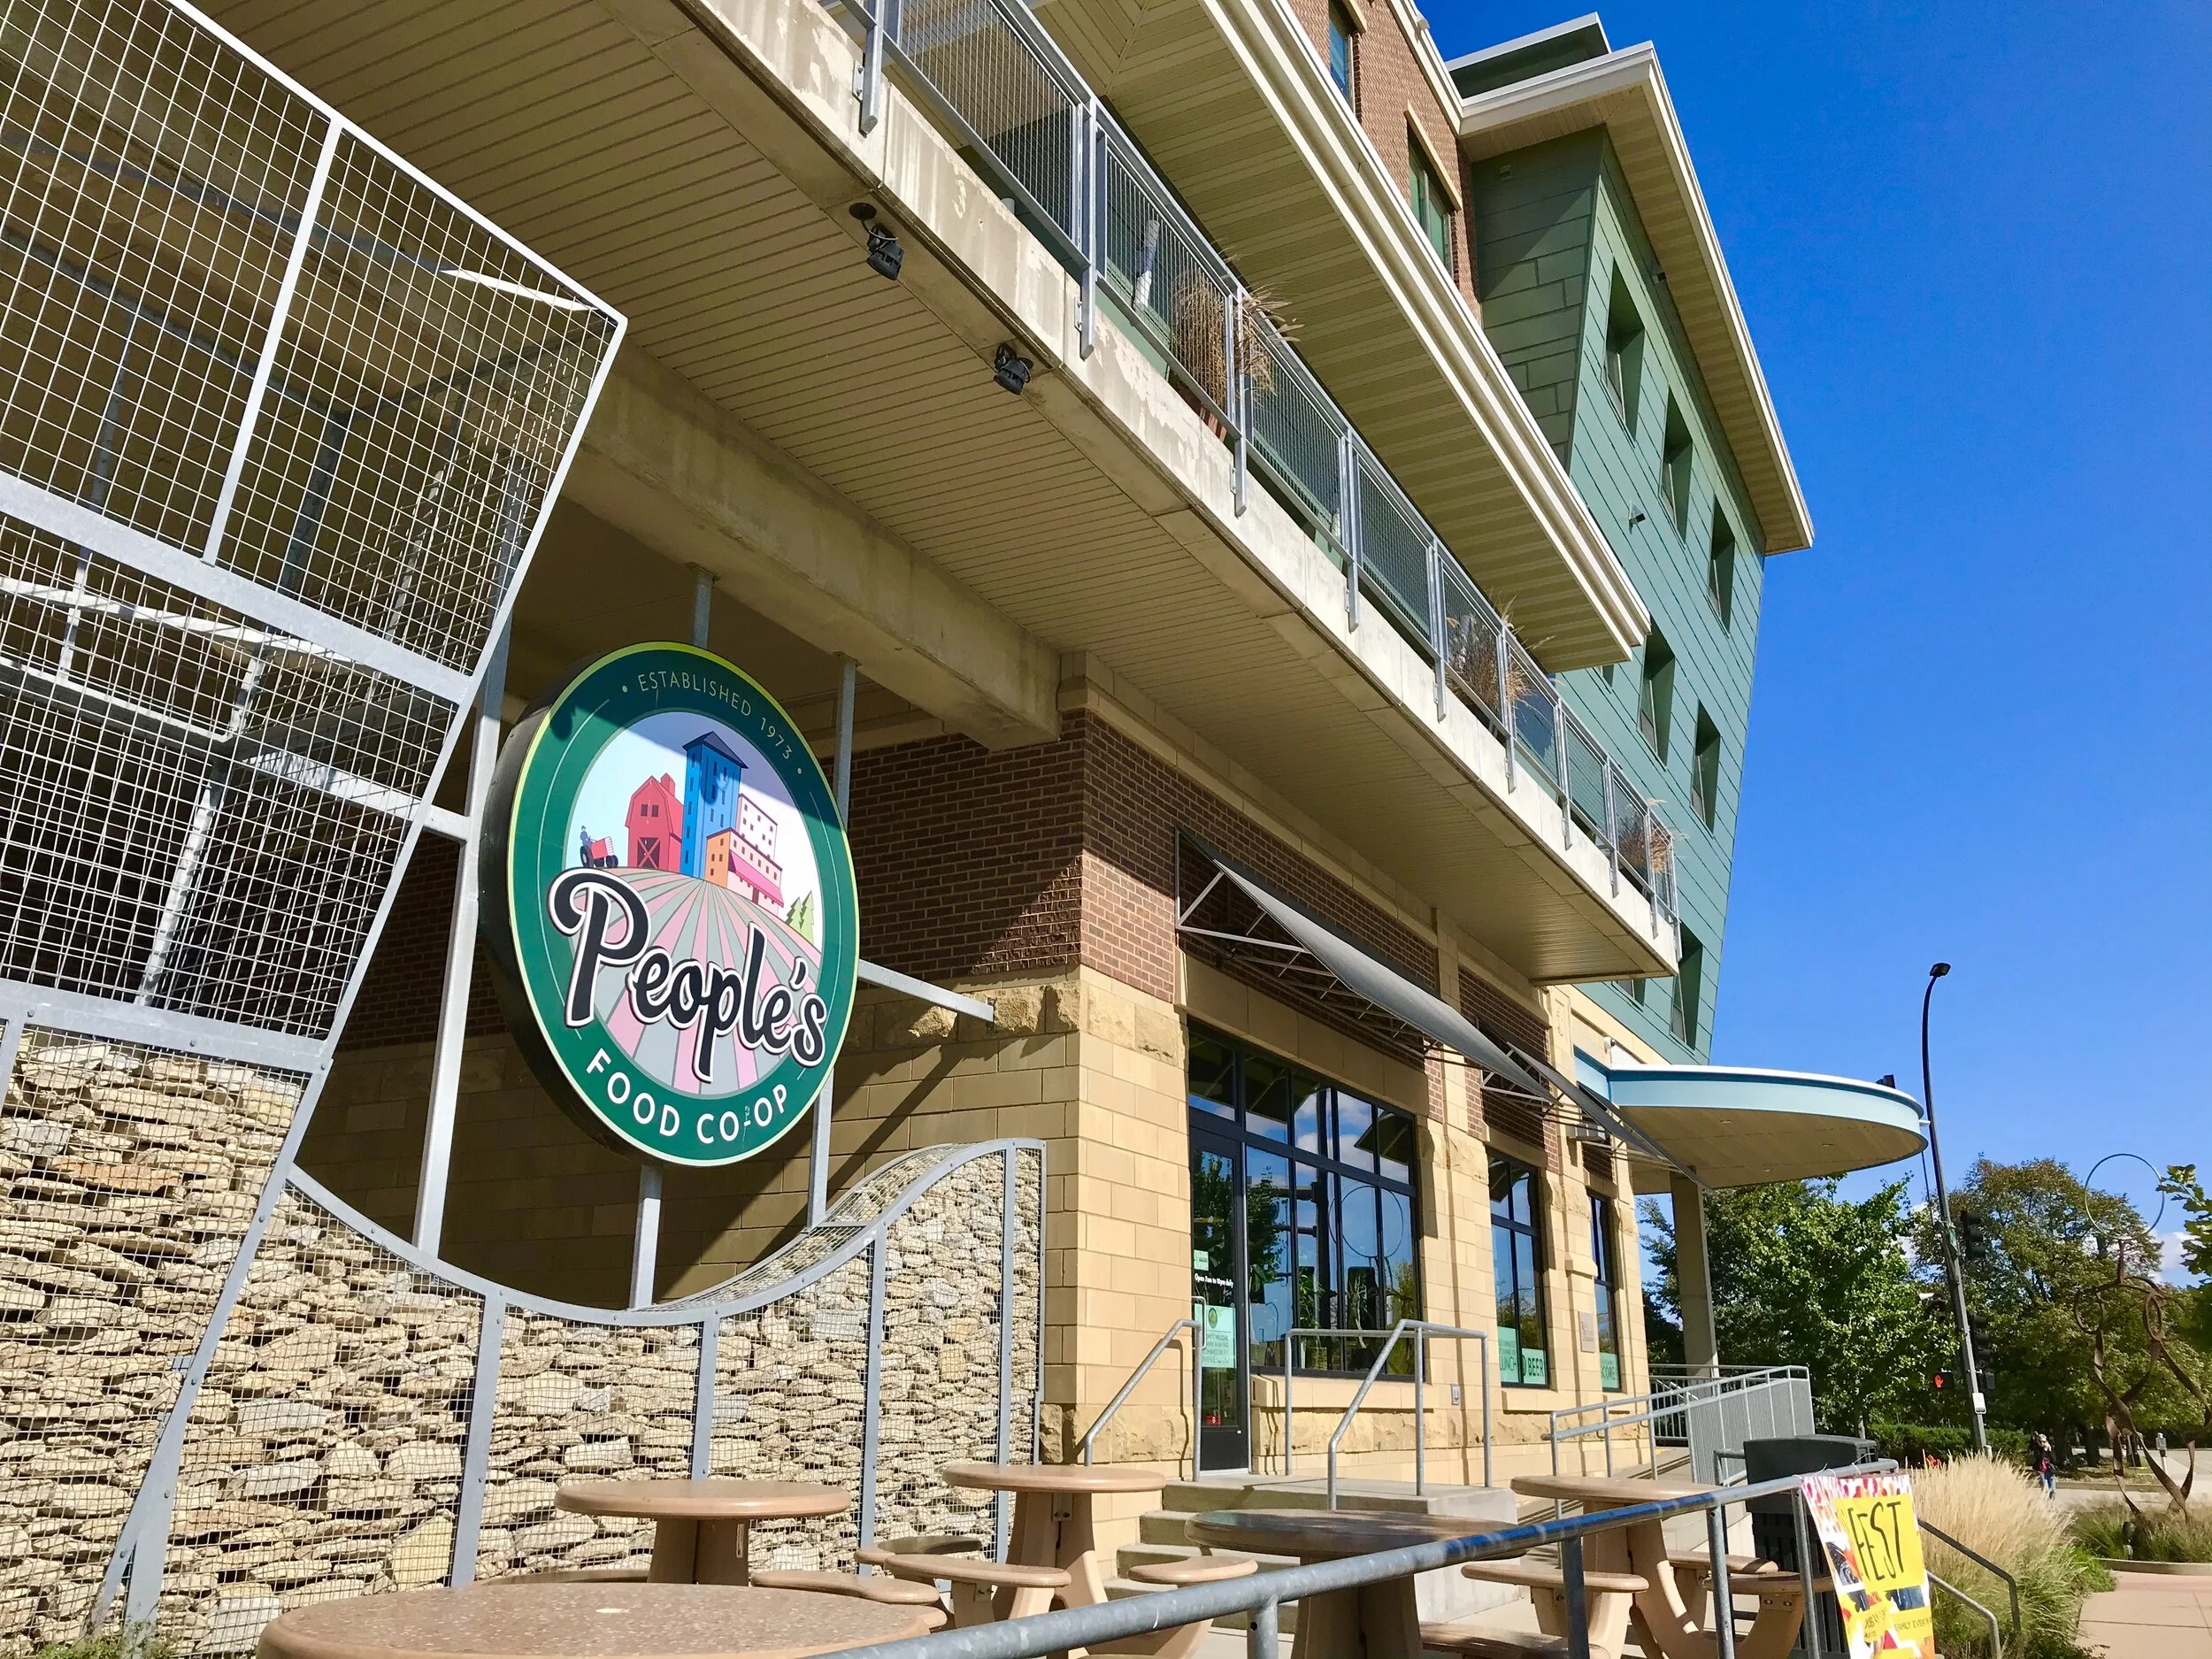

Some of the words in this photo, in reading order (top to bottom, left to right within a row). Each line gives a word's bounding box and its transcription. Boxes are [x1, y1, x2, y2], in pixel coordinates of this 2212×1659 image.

[638, 671, 751, 717] ESTABLISHED
[760, 717, 793, 759] 1973
[548, 868, 826, 1082] People's
[586, 1048, 680, 1137] FOOD
[696, 1083, 787, 1144] CO-OP
[1528, 1357, 1544, 1377] BEER
[1847, 1501, 1904, 1582] FEST
